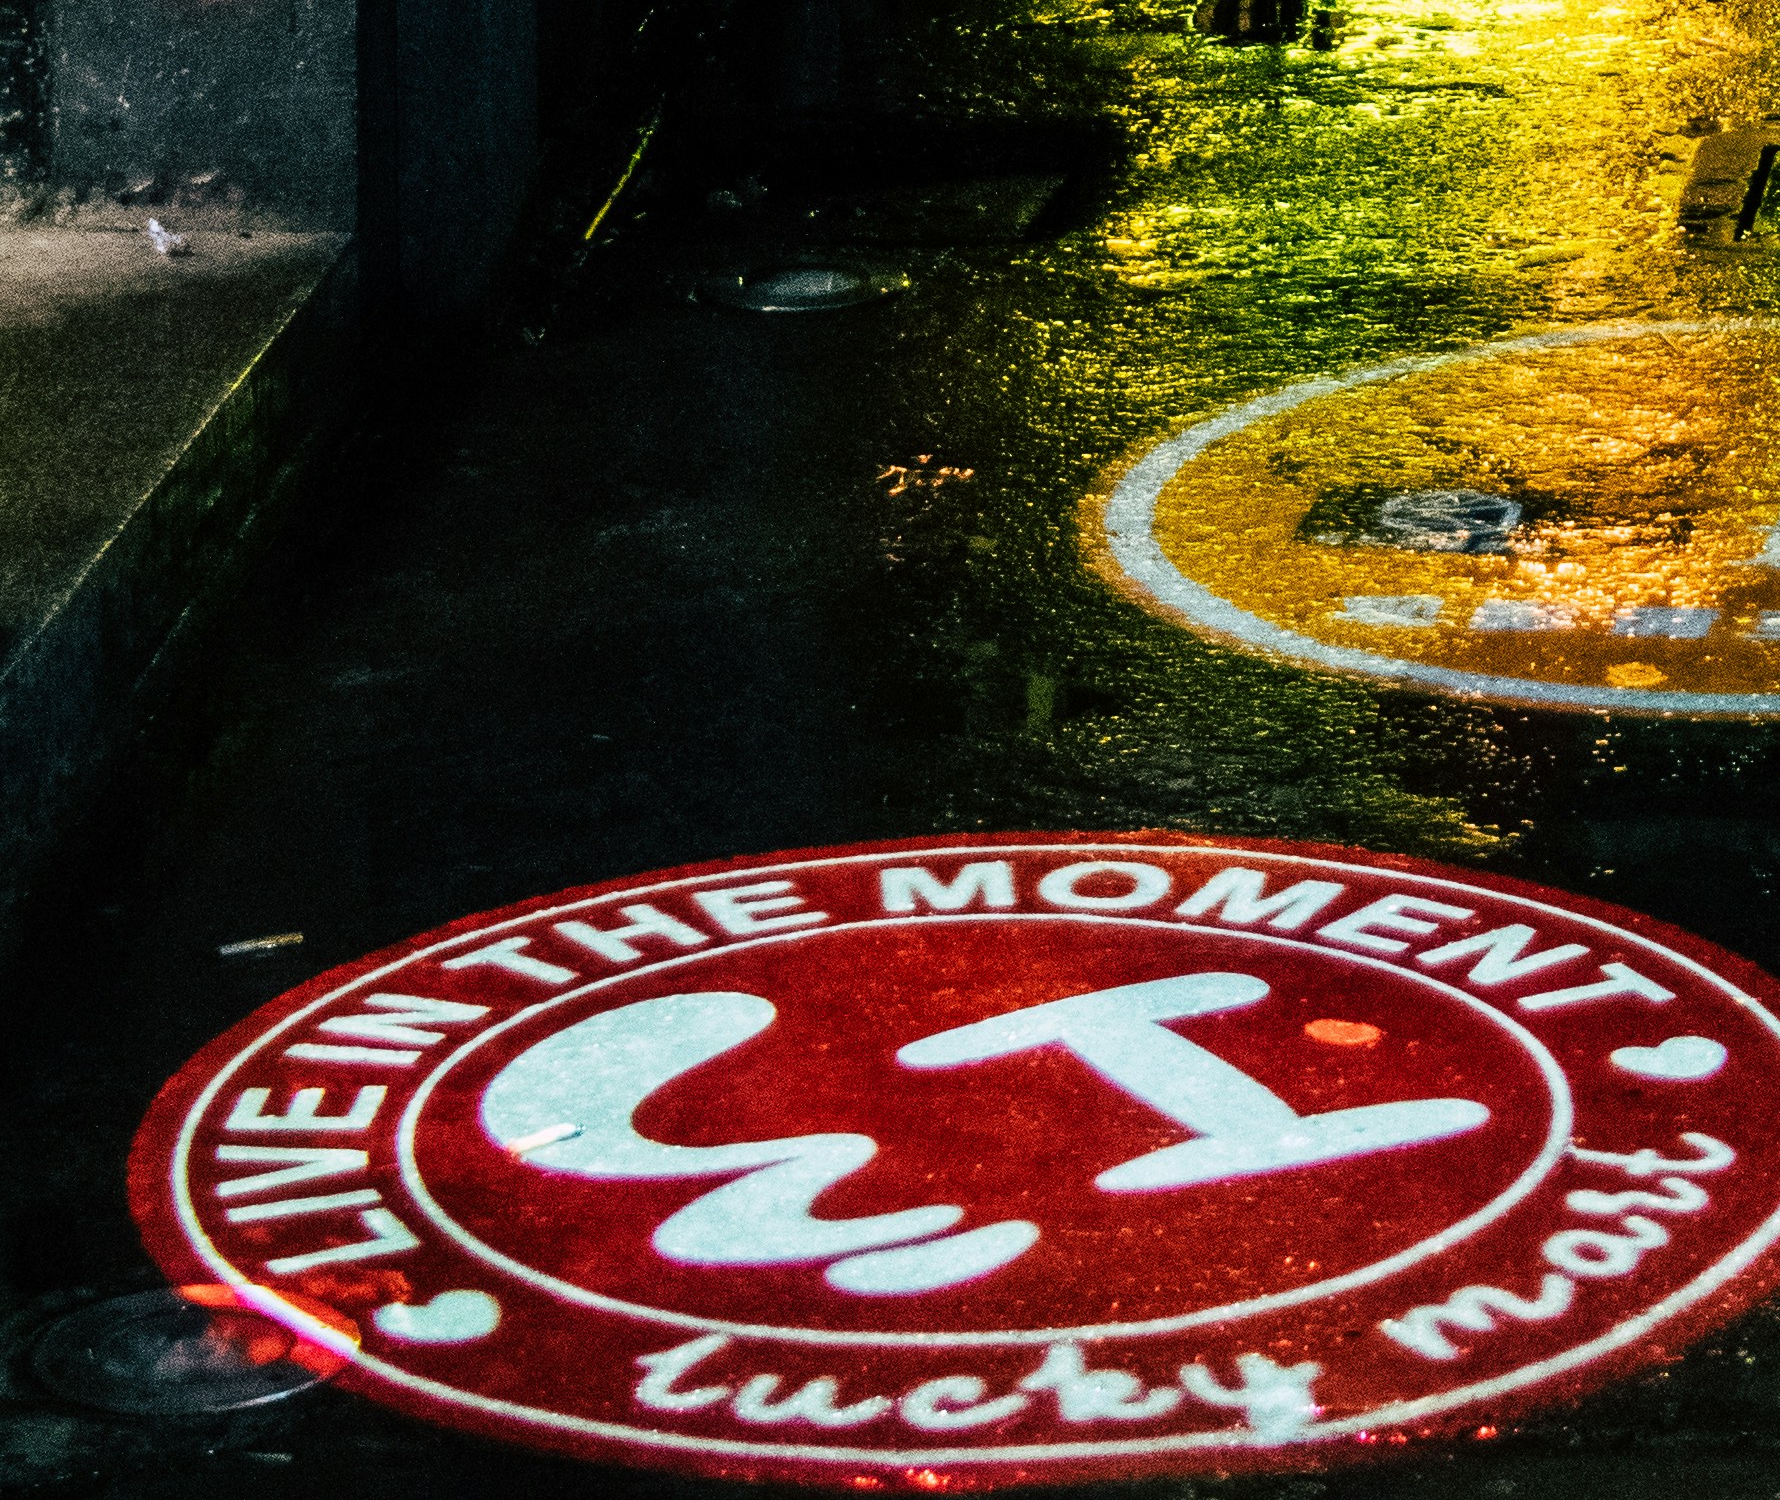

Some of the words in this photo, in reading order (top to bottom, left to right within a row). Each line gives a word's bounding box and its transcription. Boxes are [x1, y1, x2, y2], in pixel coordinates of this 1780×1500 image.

[447, 878, 828, 984] THE
[880, 858, 1677, 1012] MOMENT
[286, 991, 493, 1066] IN
[215, 1084, 421, 1276] LIVE
